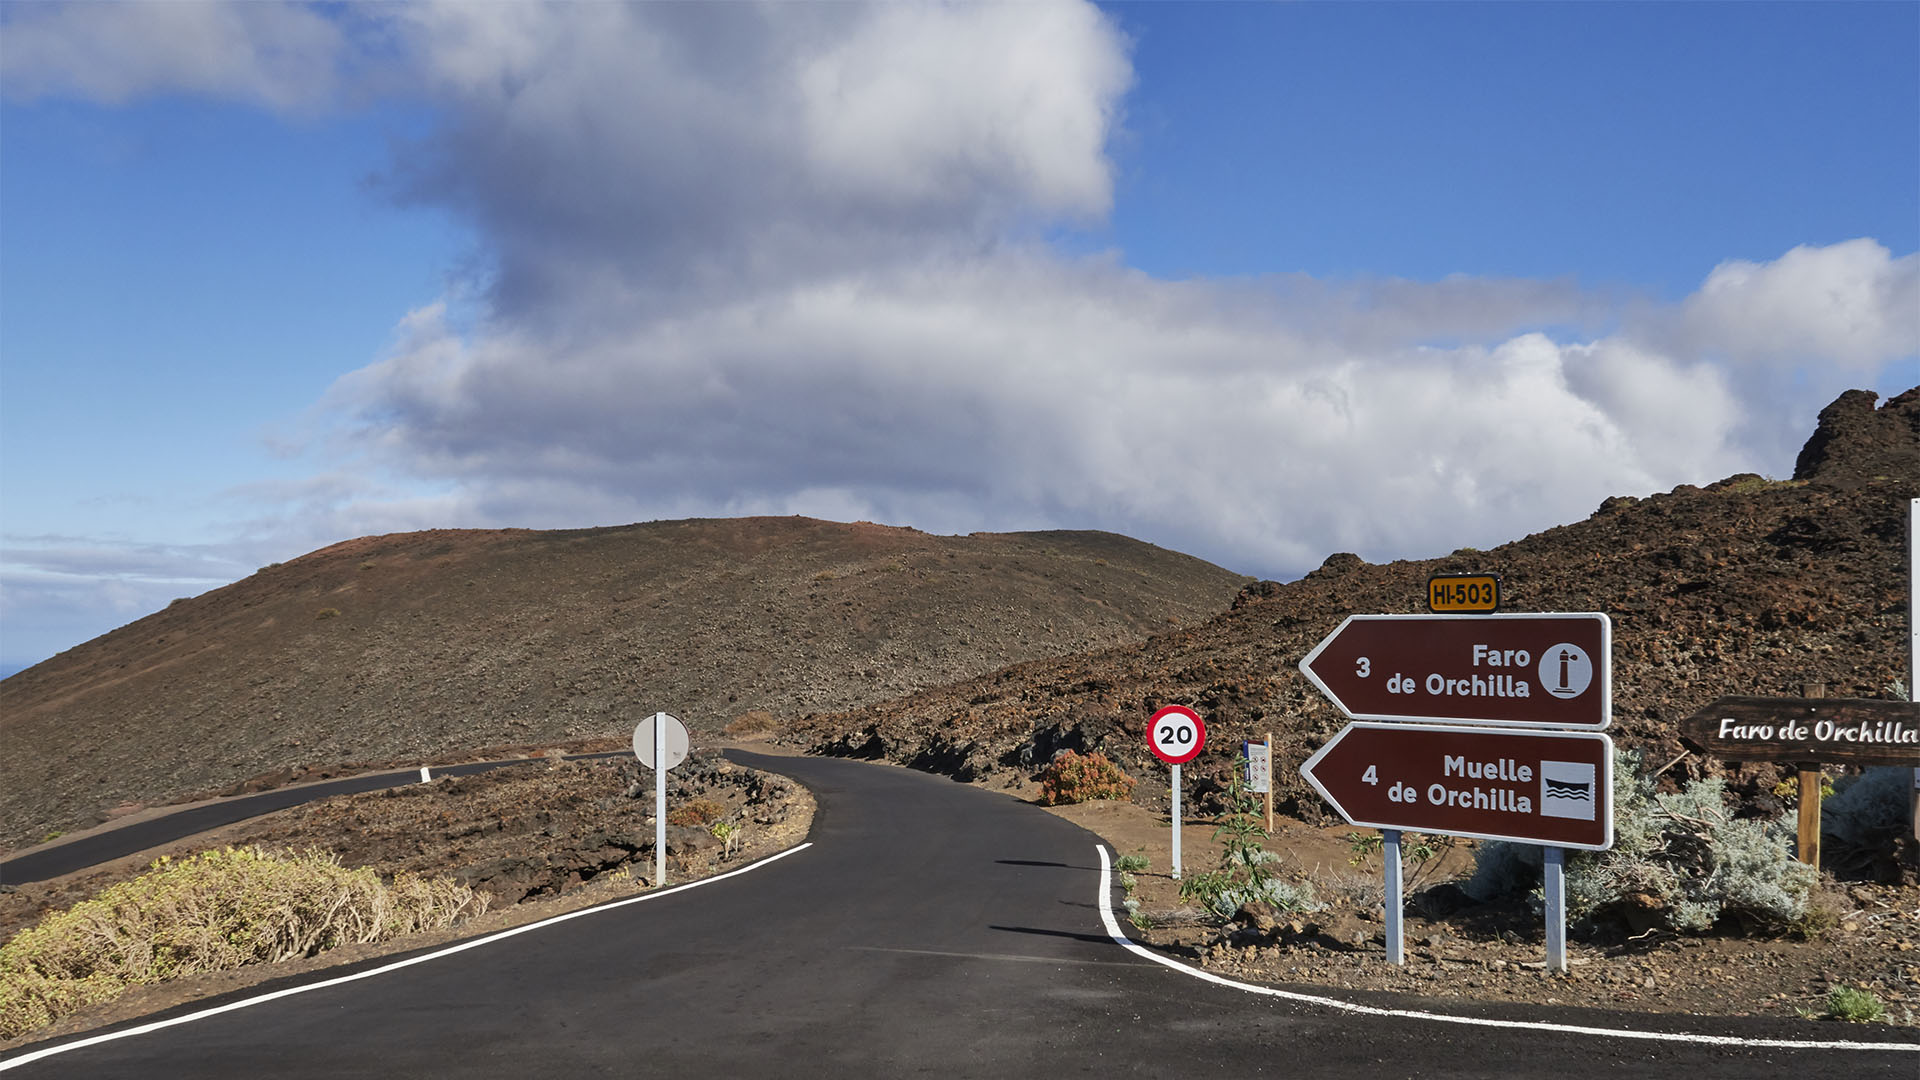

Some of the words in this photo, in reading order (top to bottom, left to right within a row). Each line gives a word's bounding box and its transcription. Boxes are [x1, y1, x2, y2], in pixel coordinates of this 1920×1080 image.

[1433, 583, 1494, 605] HI-503
[1355, 656, 1371, 678] 3
[1473, 644, 1531, 667] Faro
[1386, 672, 1416, 694] de
[1425, 673, 1530, 698] Orchilla
[1160, 725, 1192, 745] 20
[1718, 718, 1774, 741] Faro
[1778, 719, 1809, 741] de
[1814, 719, 1919, 744] Orchilla
[1361, 764, 1379, 786] 4
[1444, 754, 1533, 783] Muelle
[1387, 781, 1417, 804] de
[1427, 783, 1532, 814] Orchilla
